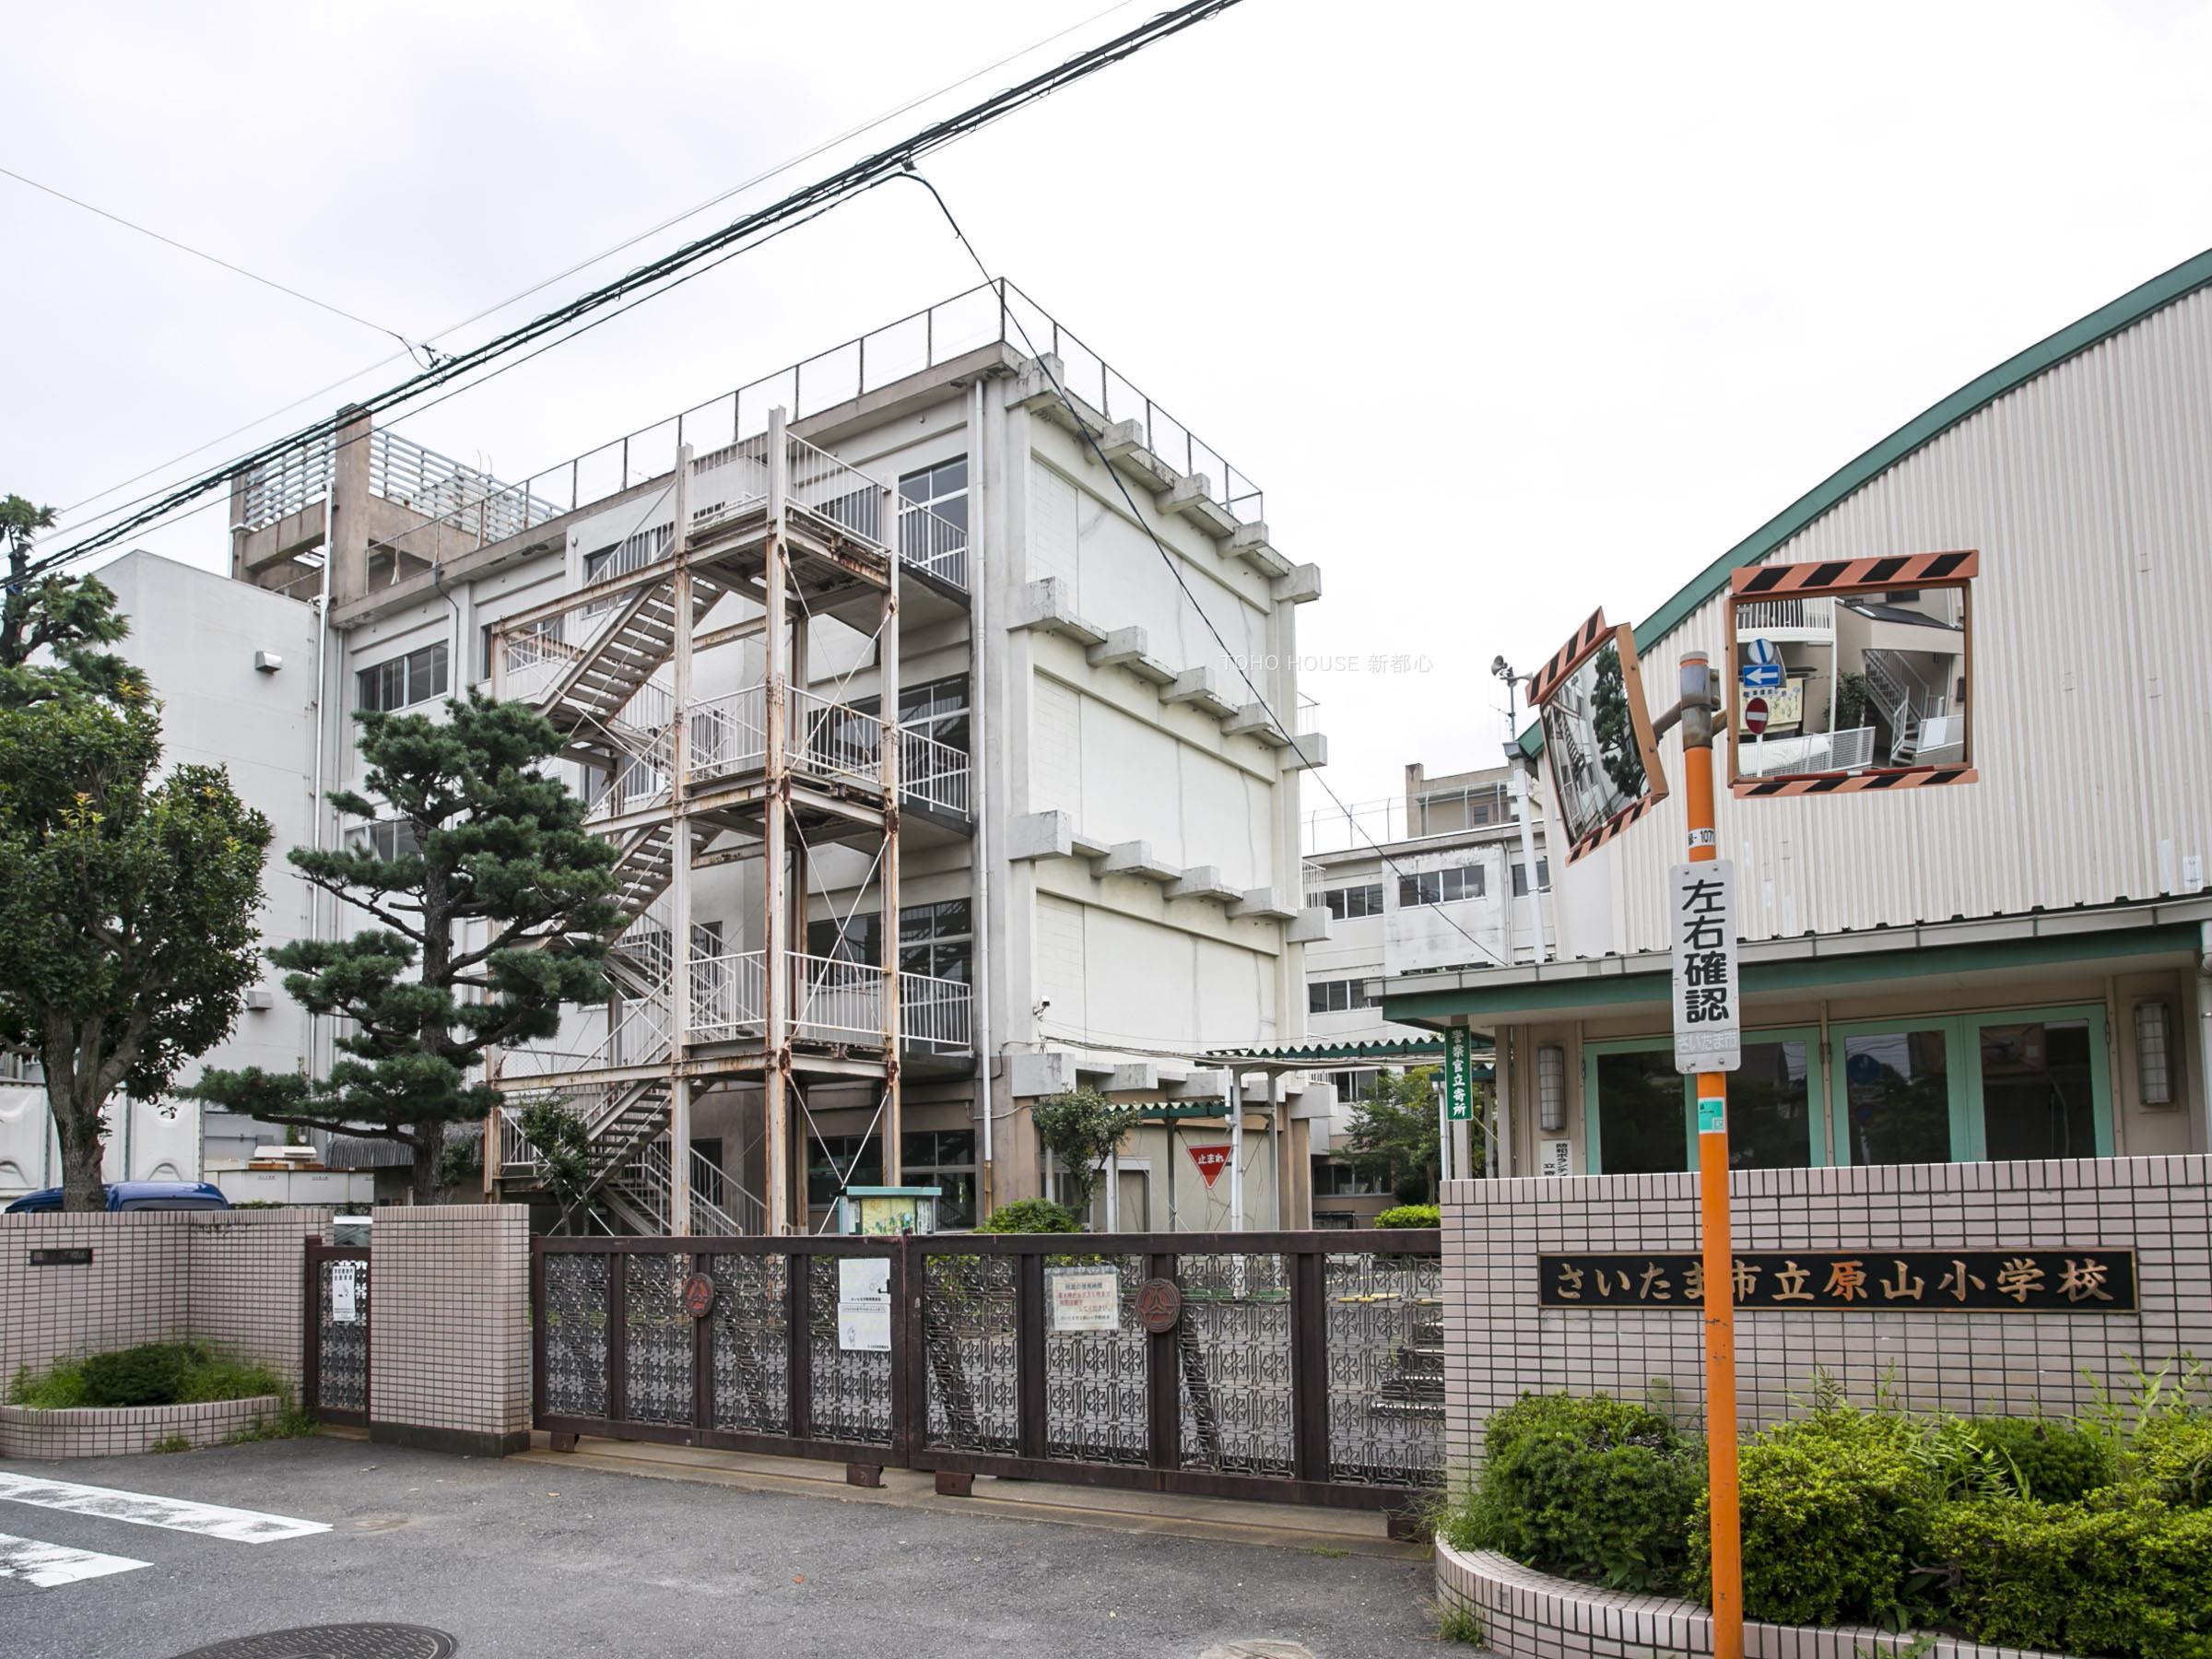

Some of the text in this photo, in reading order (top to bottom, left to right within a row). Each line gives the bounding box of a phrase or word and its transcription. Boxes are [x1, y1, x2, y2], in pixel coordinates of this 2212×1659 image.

[1682, 878, 1729, 1024] 左右確認
[1452, 1029, 1467, 1117] 警察官立寄所
[1198, 1153, 1224, 1164] 止まれ
[1558, 1258, 2114, 1303] さいたま市立原山小学校
